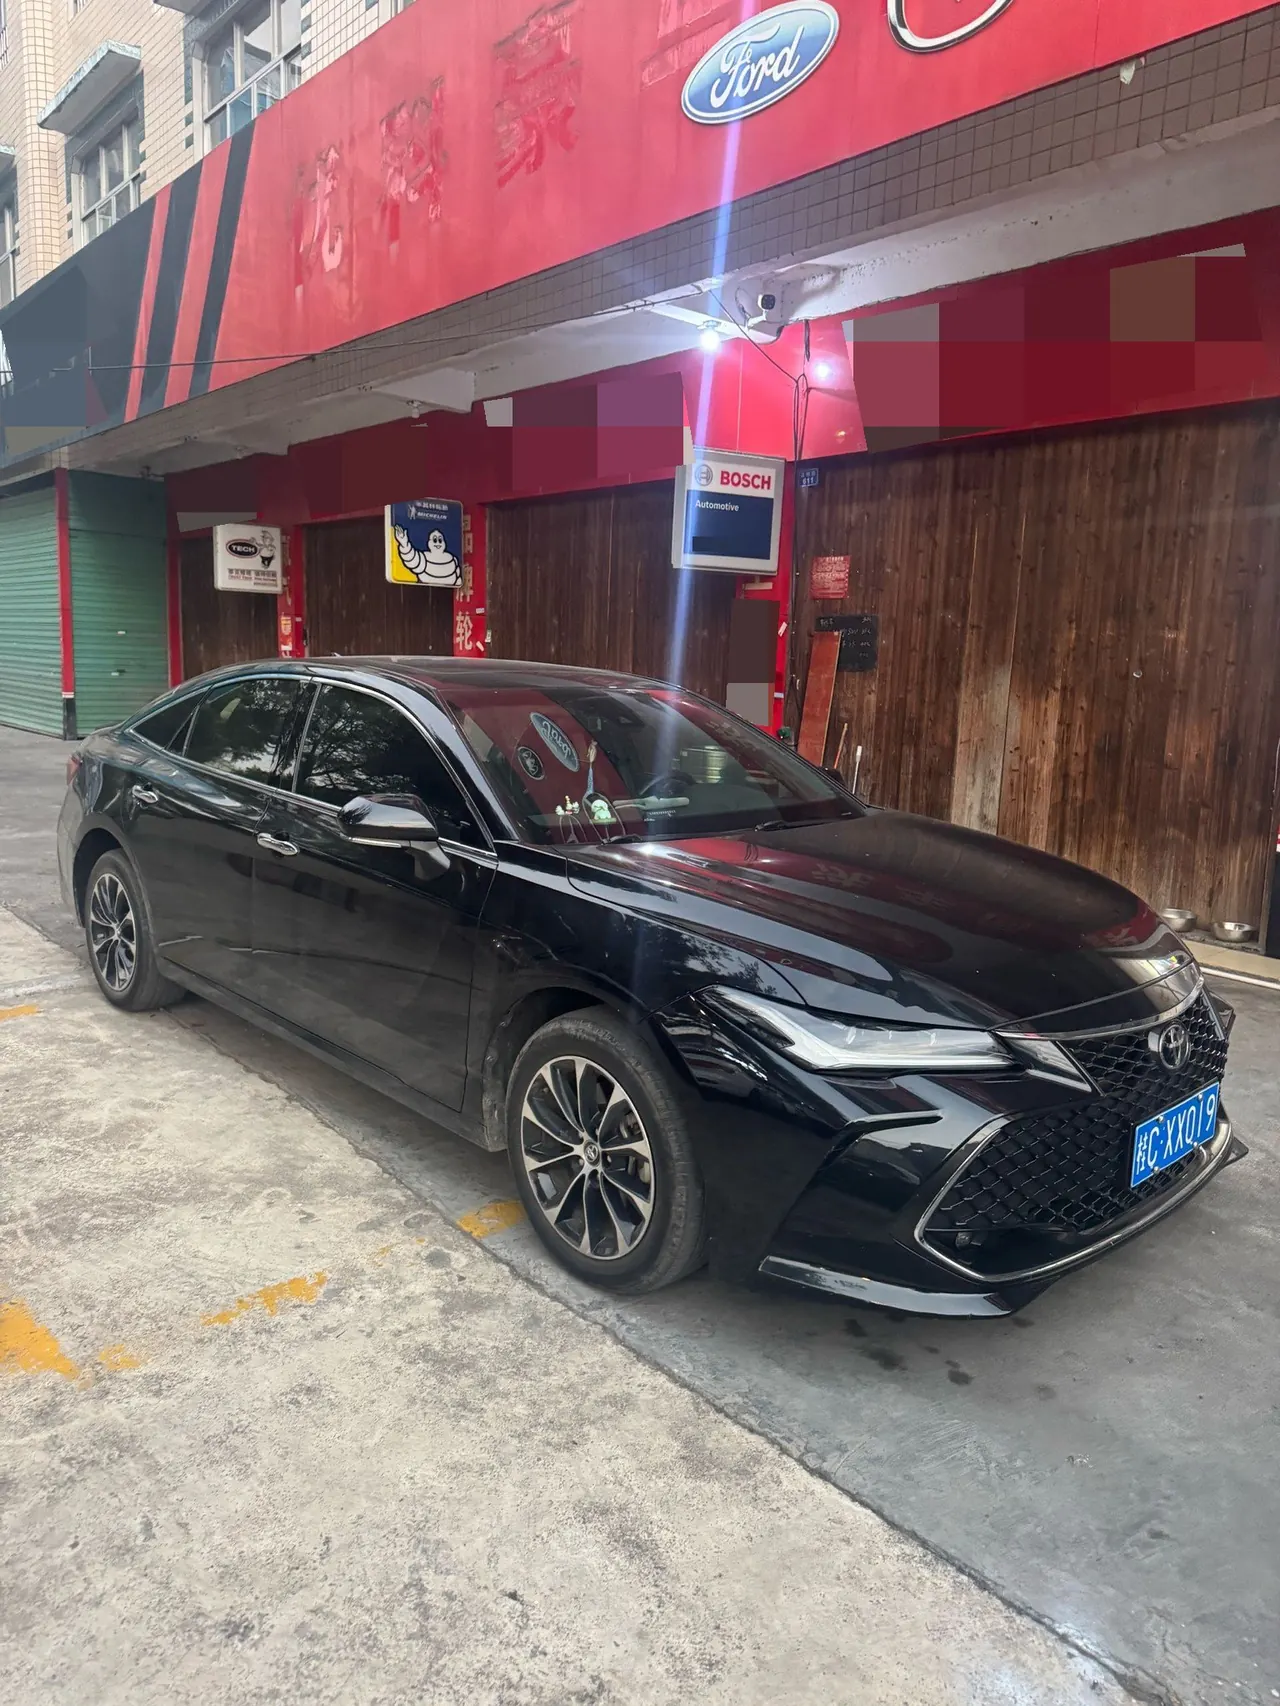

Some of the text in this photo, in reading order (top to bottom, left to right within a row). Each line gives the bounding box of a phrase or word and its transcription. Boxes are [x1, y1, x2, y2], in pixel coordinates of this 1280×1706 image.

[709, 25, 805, 109] Ford
[720, 470, 772, 491] BOSCH
[695, 499, 739, 511] Automotive
[417, 511, 447, 520] MICHELIN
[231, 544, 256, 553] TECH
